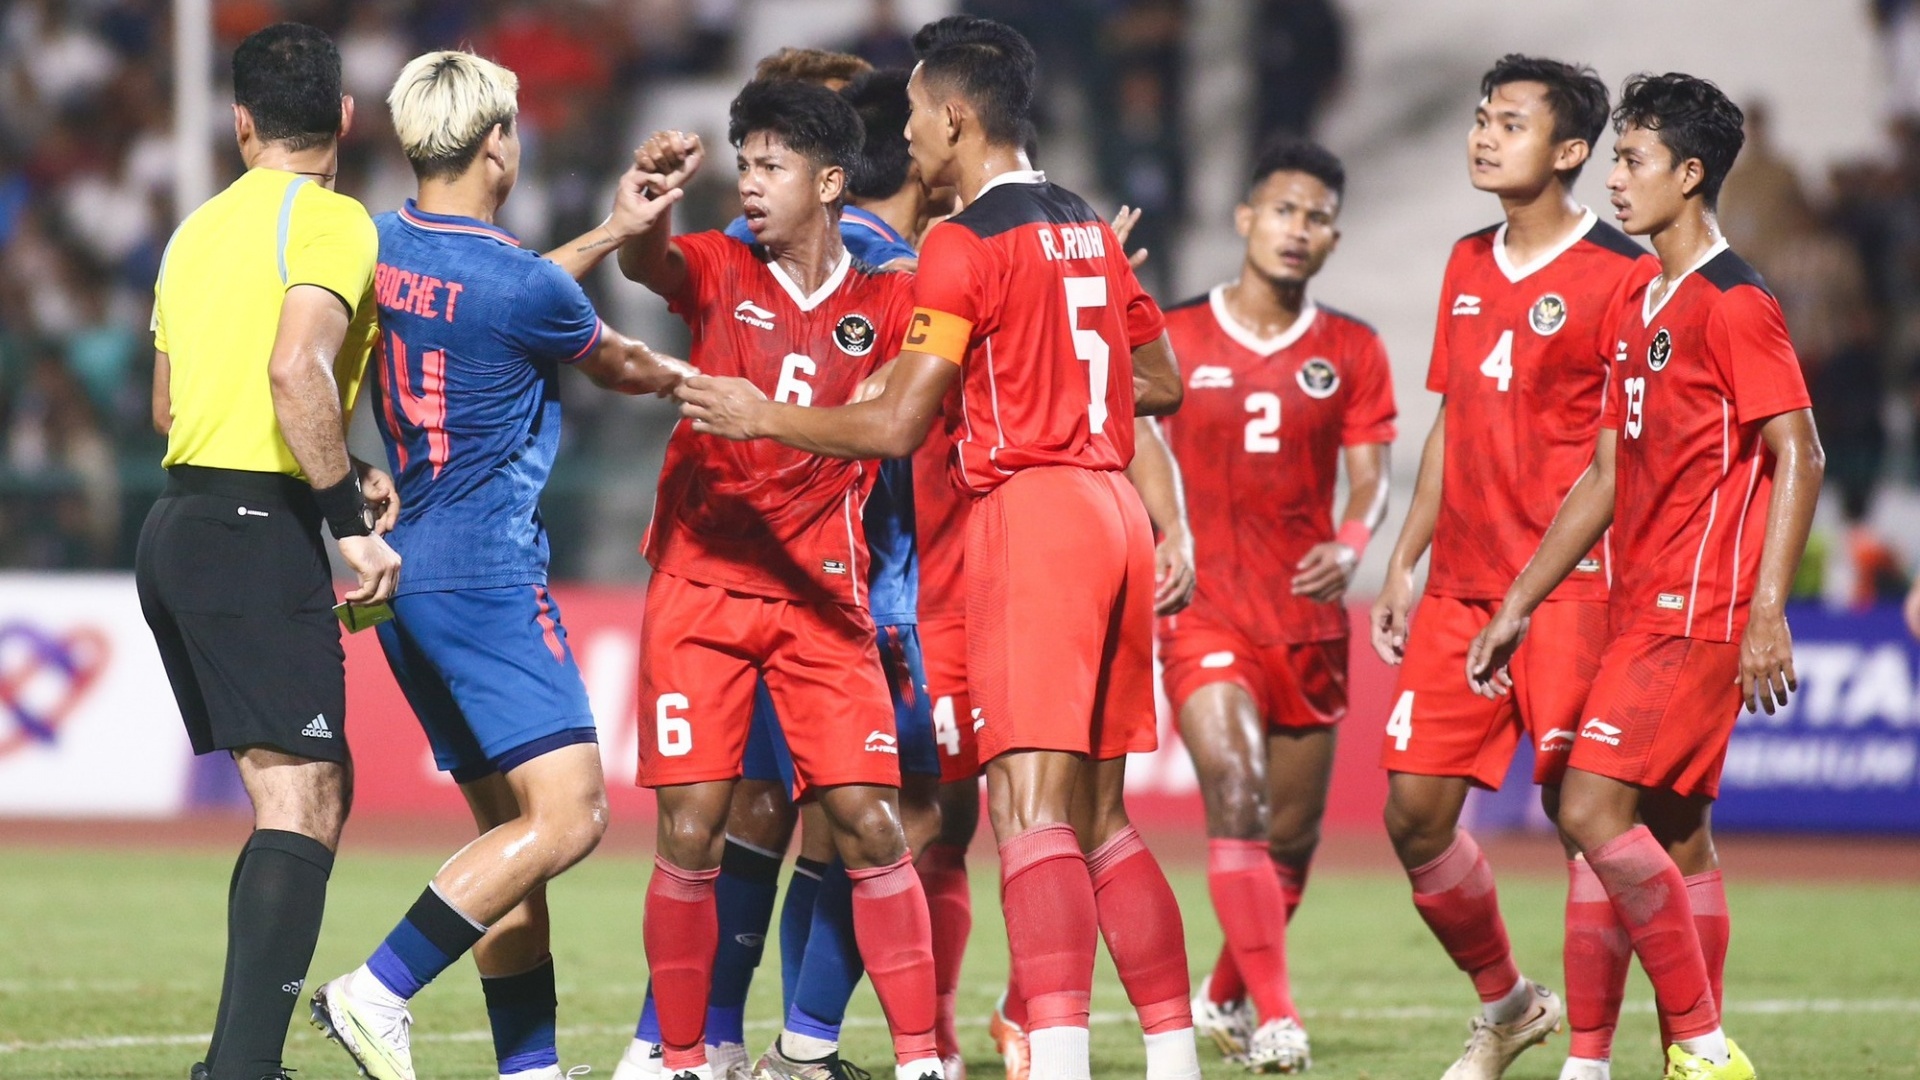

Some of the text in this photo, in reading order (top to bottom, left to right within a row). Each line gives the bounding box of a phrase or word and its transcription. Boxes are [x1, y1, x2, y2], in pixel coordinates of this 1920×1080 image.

[375, 263, 463, 323] RACHET
[907, 313, 931, 344] C
[1063, 276, 1110, 435] 5
[774, 352, 816, 408] 6
[1480, 329, 1514, 392] 4
[376, 328, 450, 481] 14
[1244, 391, 1281, 454] 2
[1624, 377, 1645, 439] 13
[301, 727, 333, 739] adidas
[656, 692, 693, 757] 6
[933, 695, 960, 756] 4
[1385, 690, 1415, 751] 4
